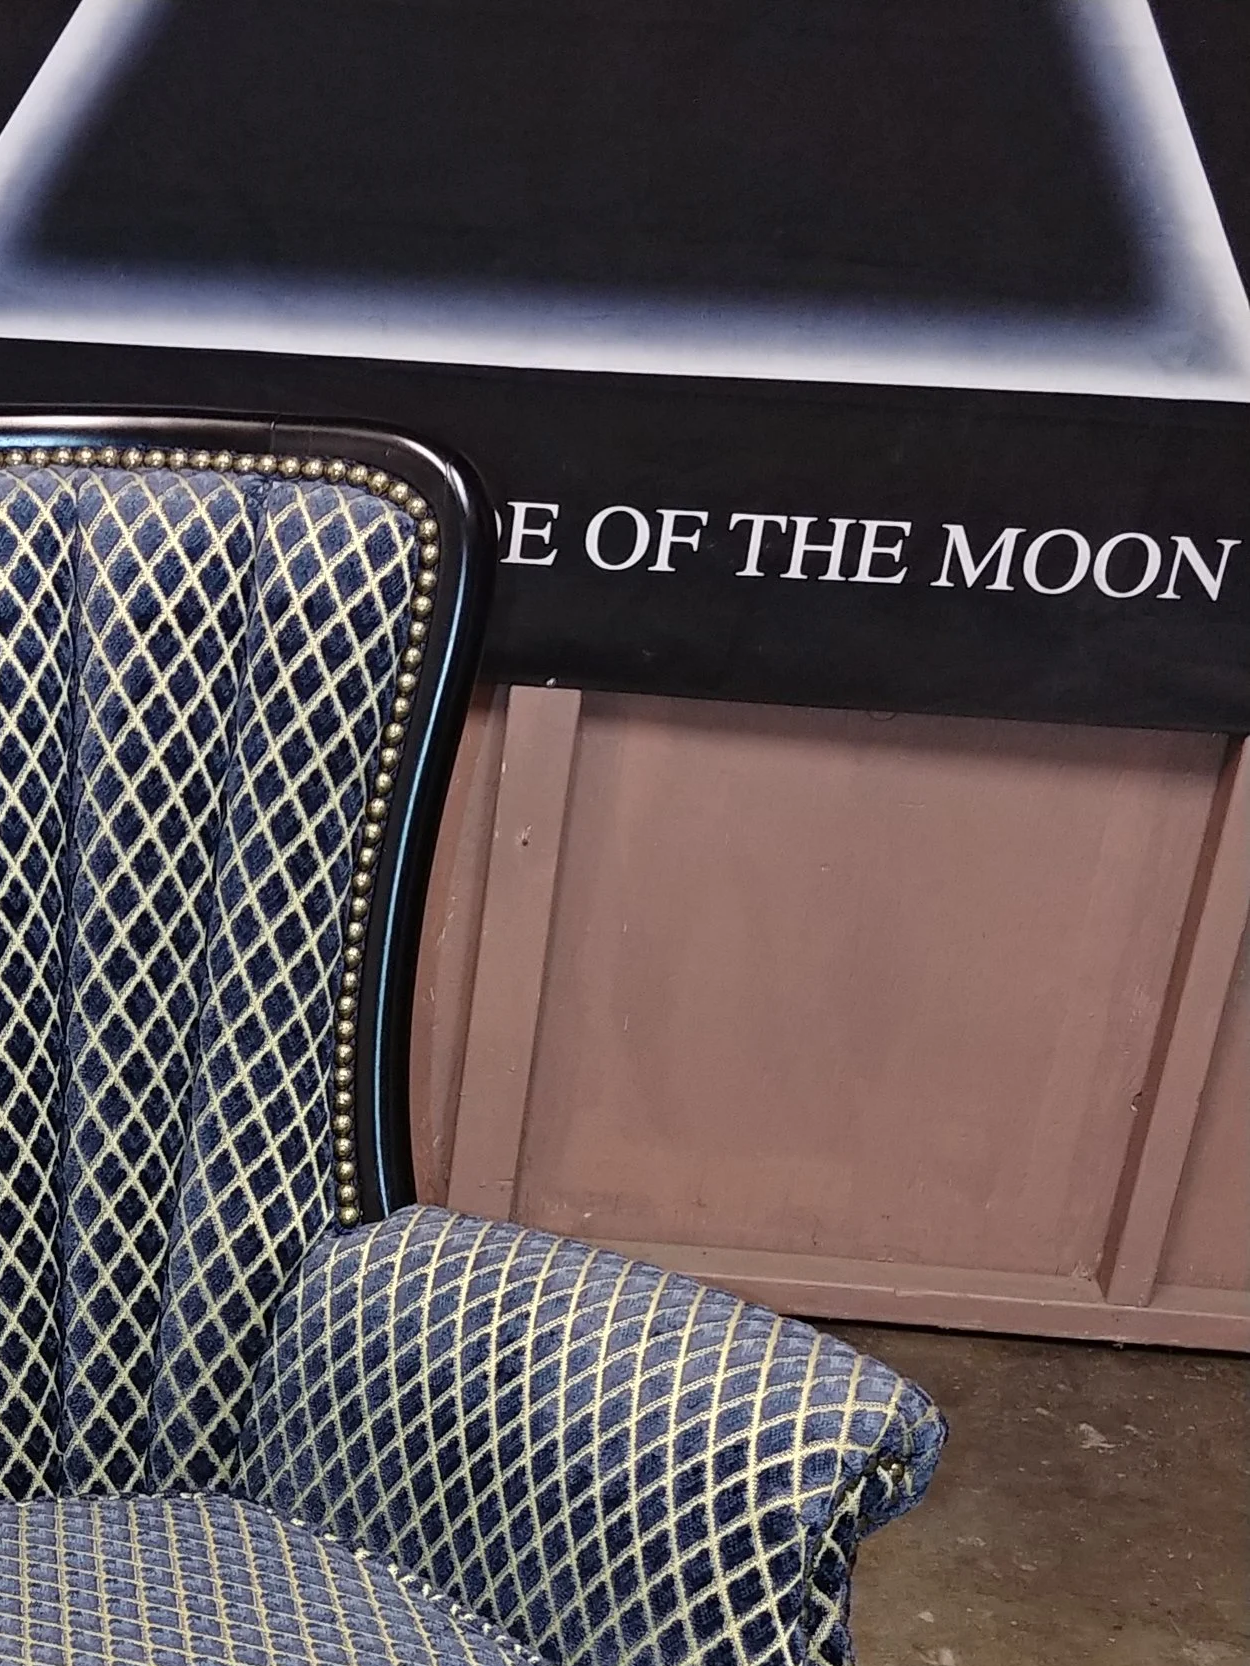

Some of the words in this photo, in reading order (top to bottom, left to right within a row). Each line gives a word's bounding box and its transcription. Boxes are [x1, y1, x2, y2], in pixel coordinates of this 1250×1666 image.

[494, 501, 560, 567] E
[584, 504, 708, 573] OF
[727, 512, 913, 585] THE
[930, 522, 1242, 602] MOON
